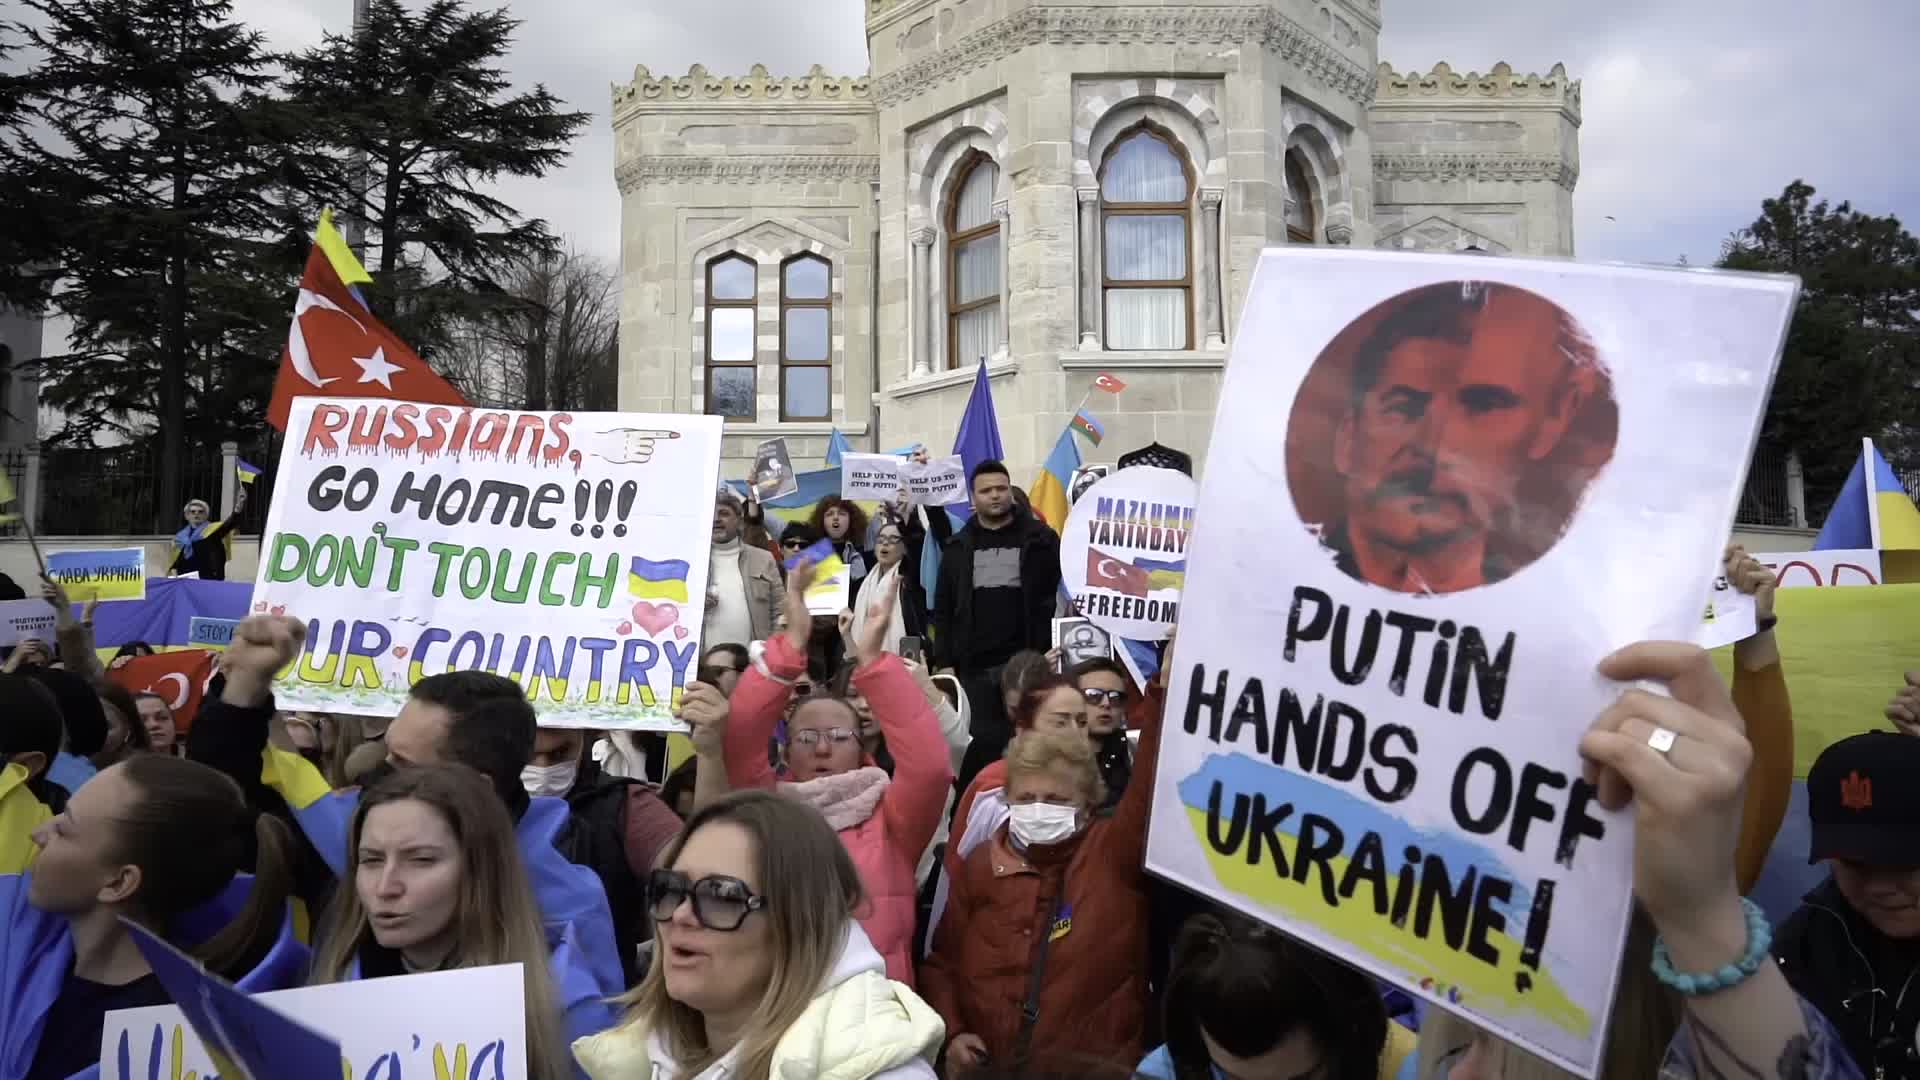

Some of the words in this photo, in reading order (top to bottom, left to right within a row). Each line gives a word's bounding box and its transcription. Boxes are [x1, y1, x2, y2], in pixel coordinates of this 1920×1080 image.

[852, 472, 873, 480] HELP
[872, 481, 897, 489] PUTIN
[909, 477, 929, 486] HELP
[931, 475, 942, 483] US
[944, 473, 956, 481] TO
[911, 486, 930, 494] STOP
[932, 483, 958, 493] PUTIN
[264, 521, 420, 593] DON'T
[428, 542, 619, 609] TOUCH
[1073, 593, 1177, 624] #FREEDOM
[199, 623, 228, 641] STOP
[274, 618, 392, 689] UR
[1183, 663, 1419, 803] HANDS
[1450, 747, 1606, 871] OFF
